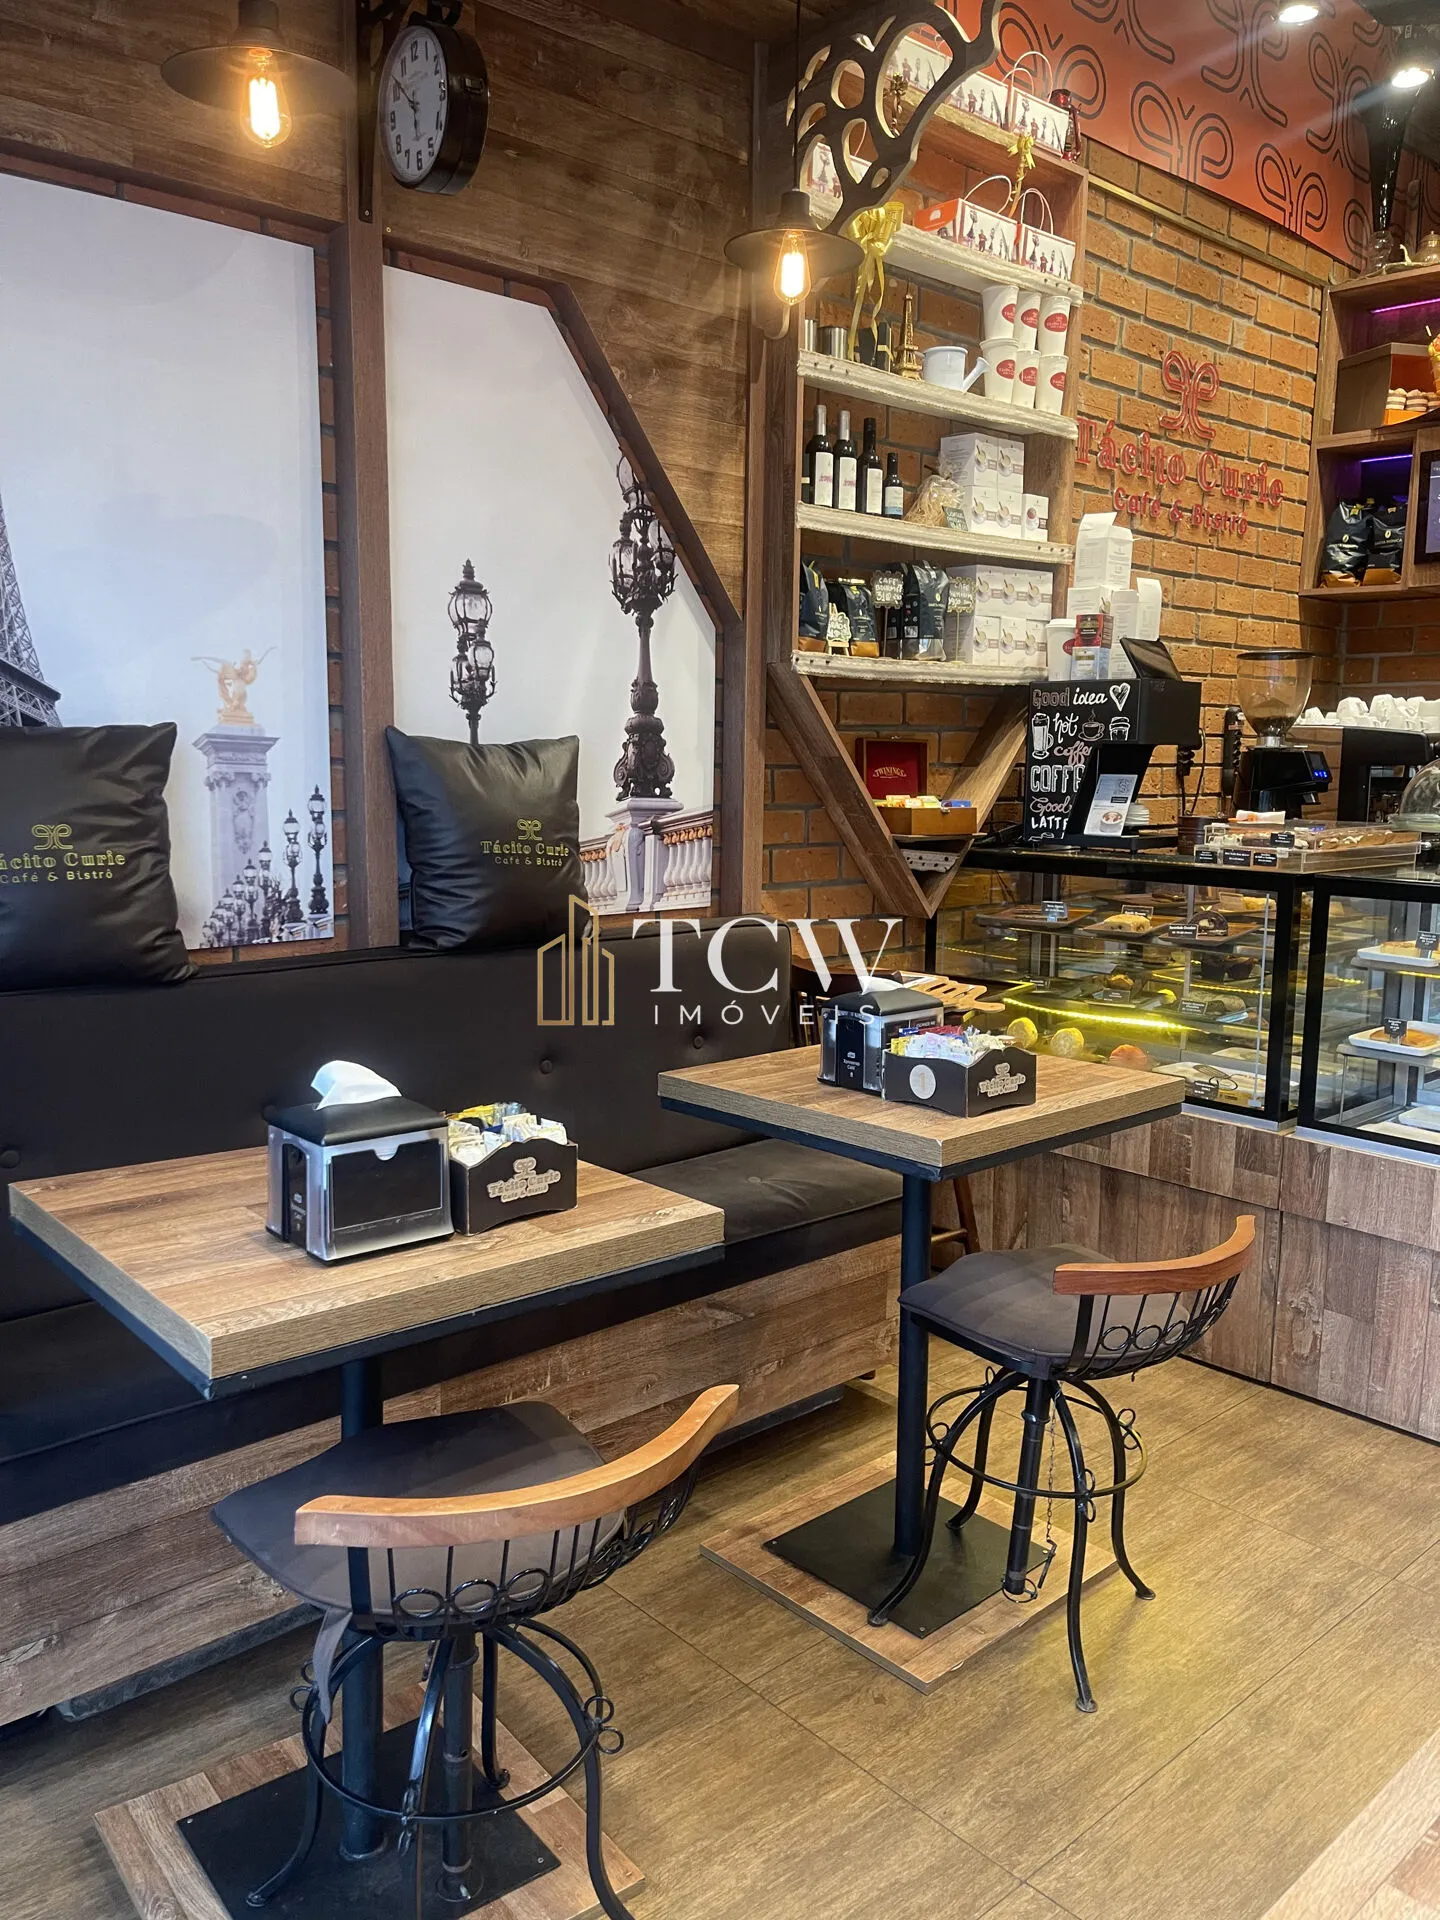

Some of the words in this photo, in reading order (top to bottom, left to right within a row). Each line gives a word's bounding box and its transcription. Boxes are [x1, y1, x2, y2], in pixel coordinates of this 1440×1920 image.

[410, 41, 419, 62] 12
[400, 56, 407, 77] 11
[433, 55, 440, 76] 2
[438, 80, 446, 101] 3
[390, 111, 396, 131] 9
[395, 134, 402, 154] 8
[427, 136, 434, 157] 5
[404, 149, 410, 170] 7
[416, 151, 423, 171] 6
[1075, 416, 1187, 485] Tácito
[1197, 450, 1285, 507] Curie
[1113, 487, 1161, 518] Café
[1168, 500, 1184, 522] &
[1032, 687, 1070, 710] Good
[1072, 687, 1108, 705] idea
[1052, 712, 1080, 744] hot
[1053, 740, 1093, 767] coffe
[874, 766, 905, 777] TWININGS
[1030, 795, 1072, 817] Good
[480, 840, 532, 855] Tácito
[535, 842, 570, 857] Curie
[0, 852, 57, 870] ácito
[64, 849, 126, 867] Curie
[494, 856, 520, 865] Café
[524, 857, 532, 865] &
[0, 872, 38, 884] Café
[48, 871, 59, 882] &
[66, 869, 113, 881] Bistrô
